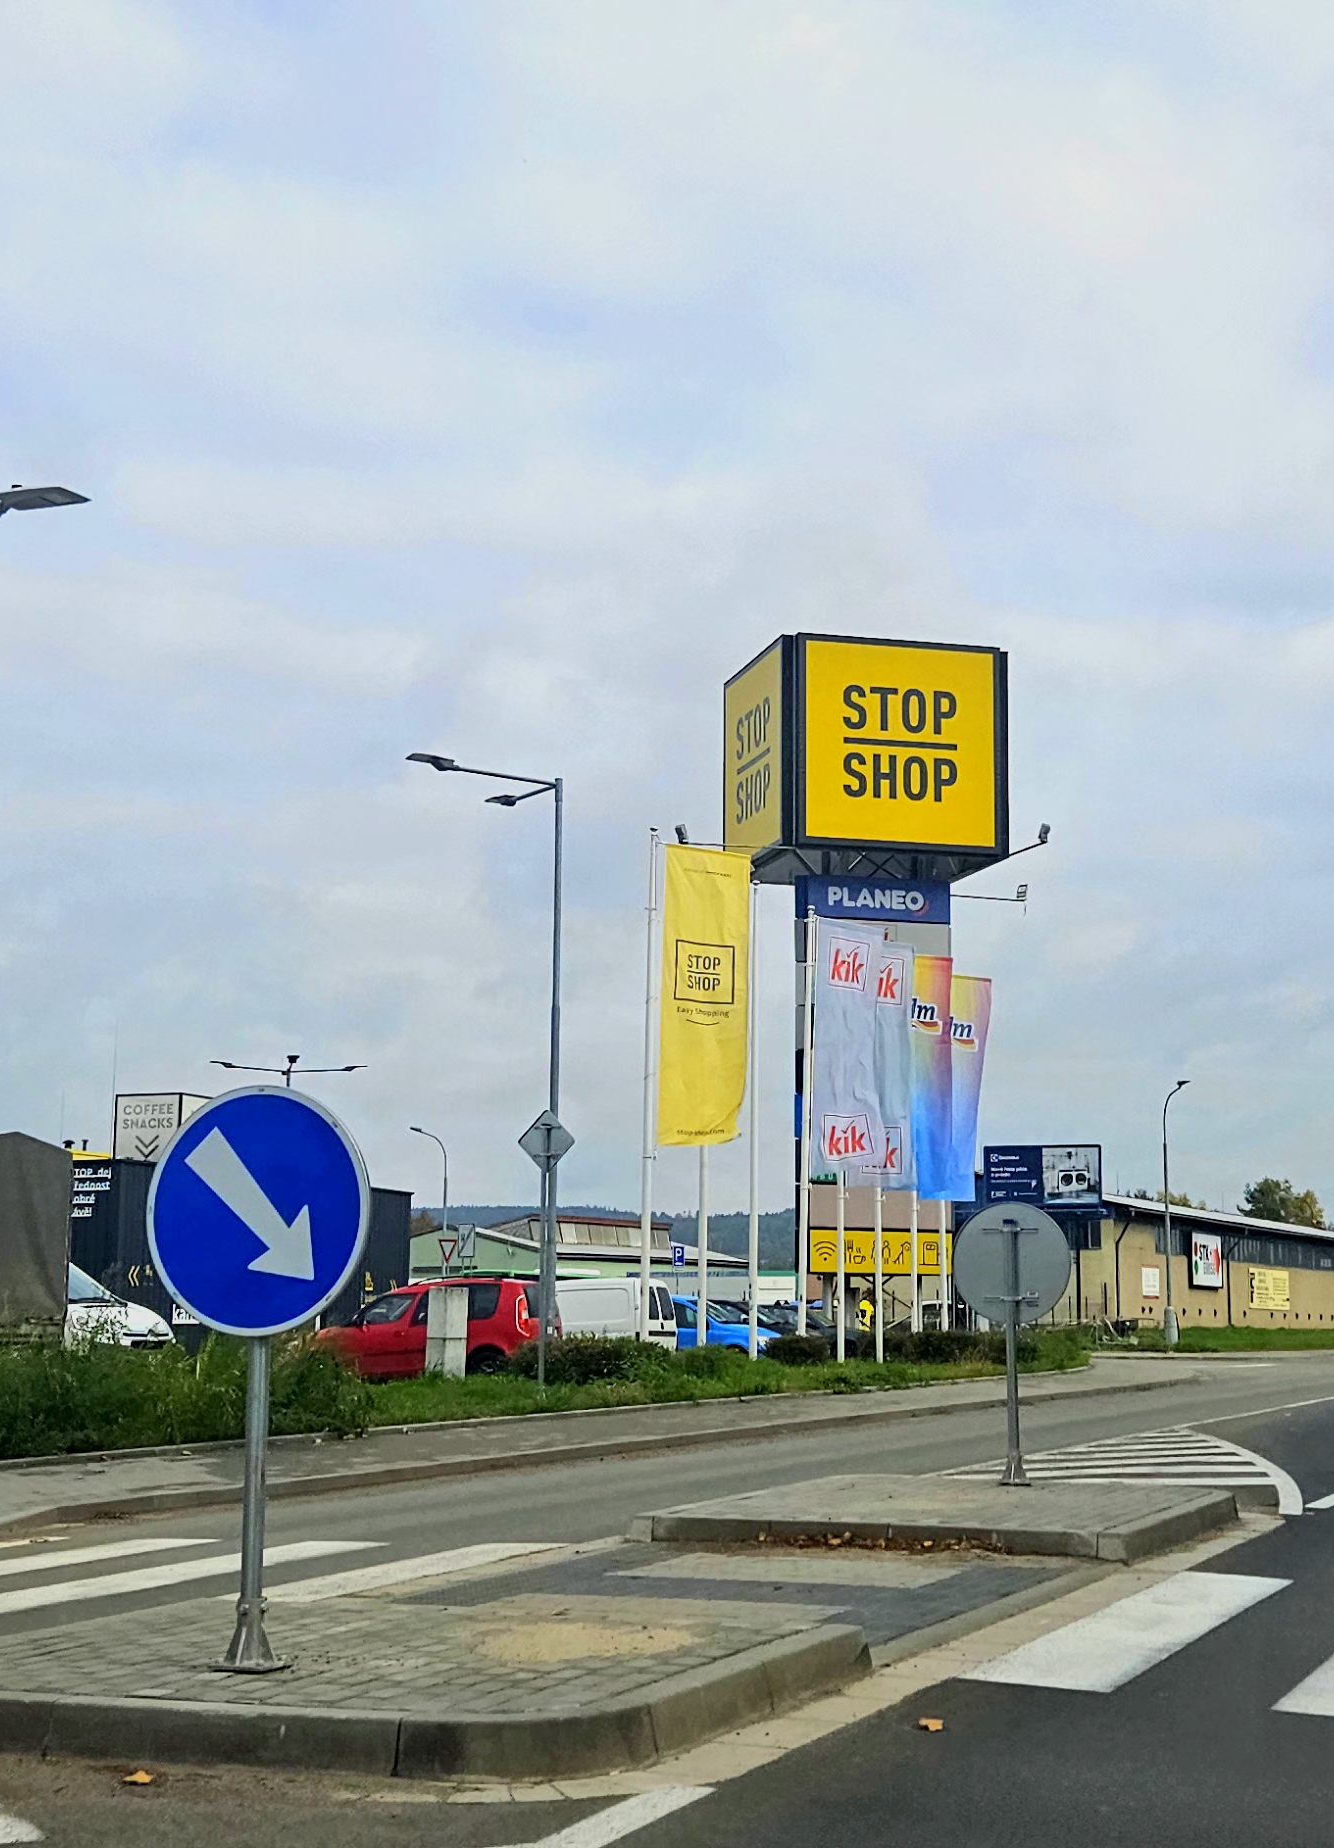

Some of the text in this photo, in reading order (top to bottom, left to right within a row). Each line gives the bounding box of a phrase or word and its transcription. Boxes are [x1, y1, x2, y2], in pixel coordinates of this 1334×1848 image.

[842, 684, 957, 735] STOP
[736, 696, 771, 760] STOP
[842, 752, 958, 803] SHOP
[736, 763, 771, 825] SHOP
[828, 886, 924, 911] PLANEO
[687, 954, 721, 971] STOP
[831, 946, 865, 984] kik
[687, 974, 721, 991] SHOP
[877, 961, 899, 999] ik
[676, 1005, 730, 1019] Easy Shopping
[123, 1103, 174, 1115] COFFEE
[122, 1117, 173, 1129] SNACKS
[828, 1120, 866, 1156] kik
[97, 1166, 112, 1179] dej
[1199, 1243, 1209, 1262] STK
